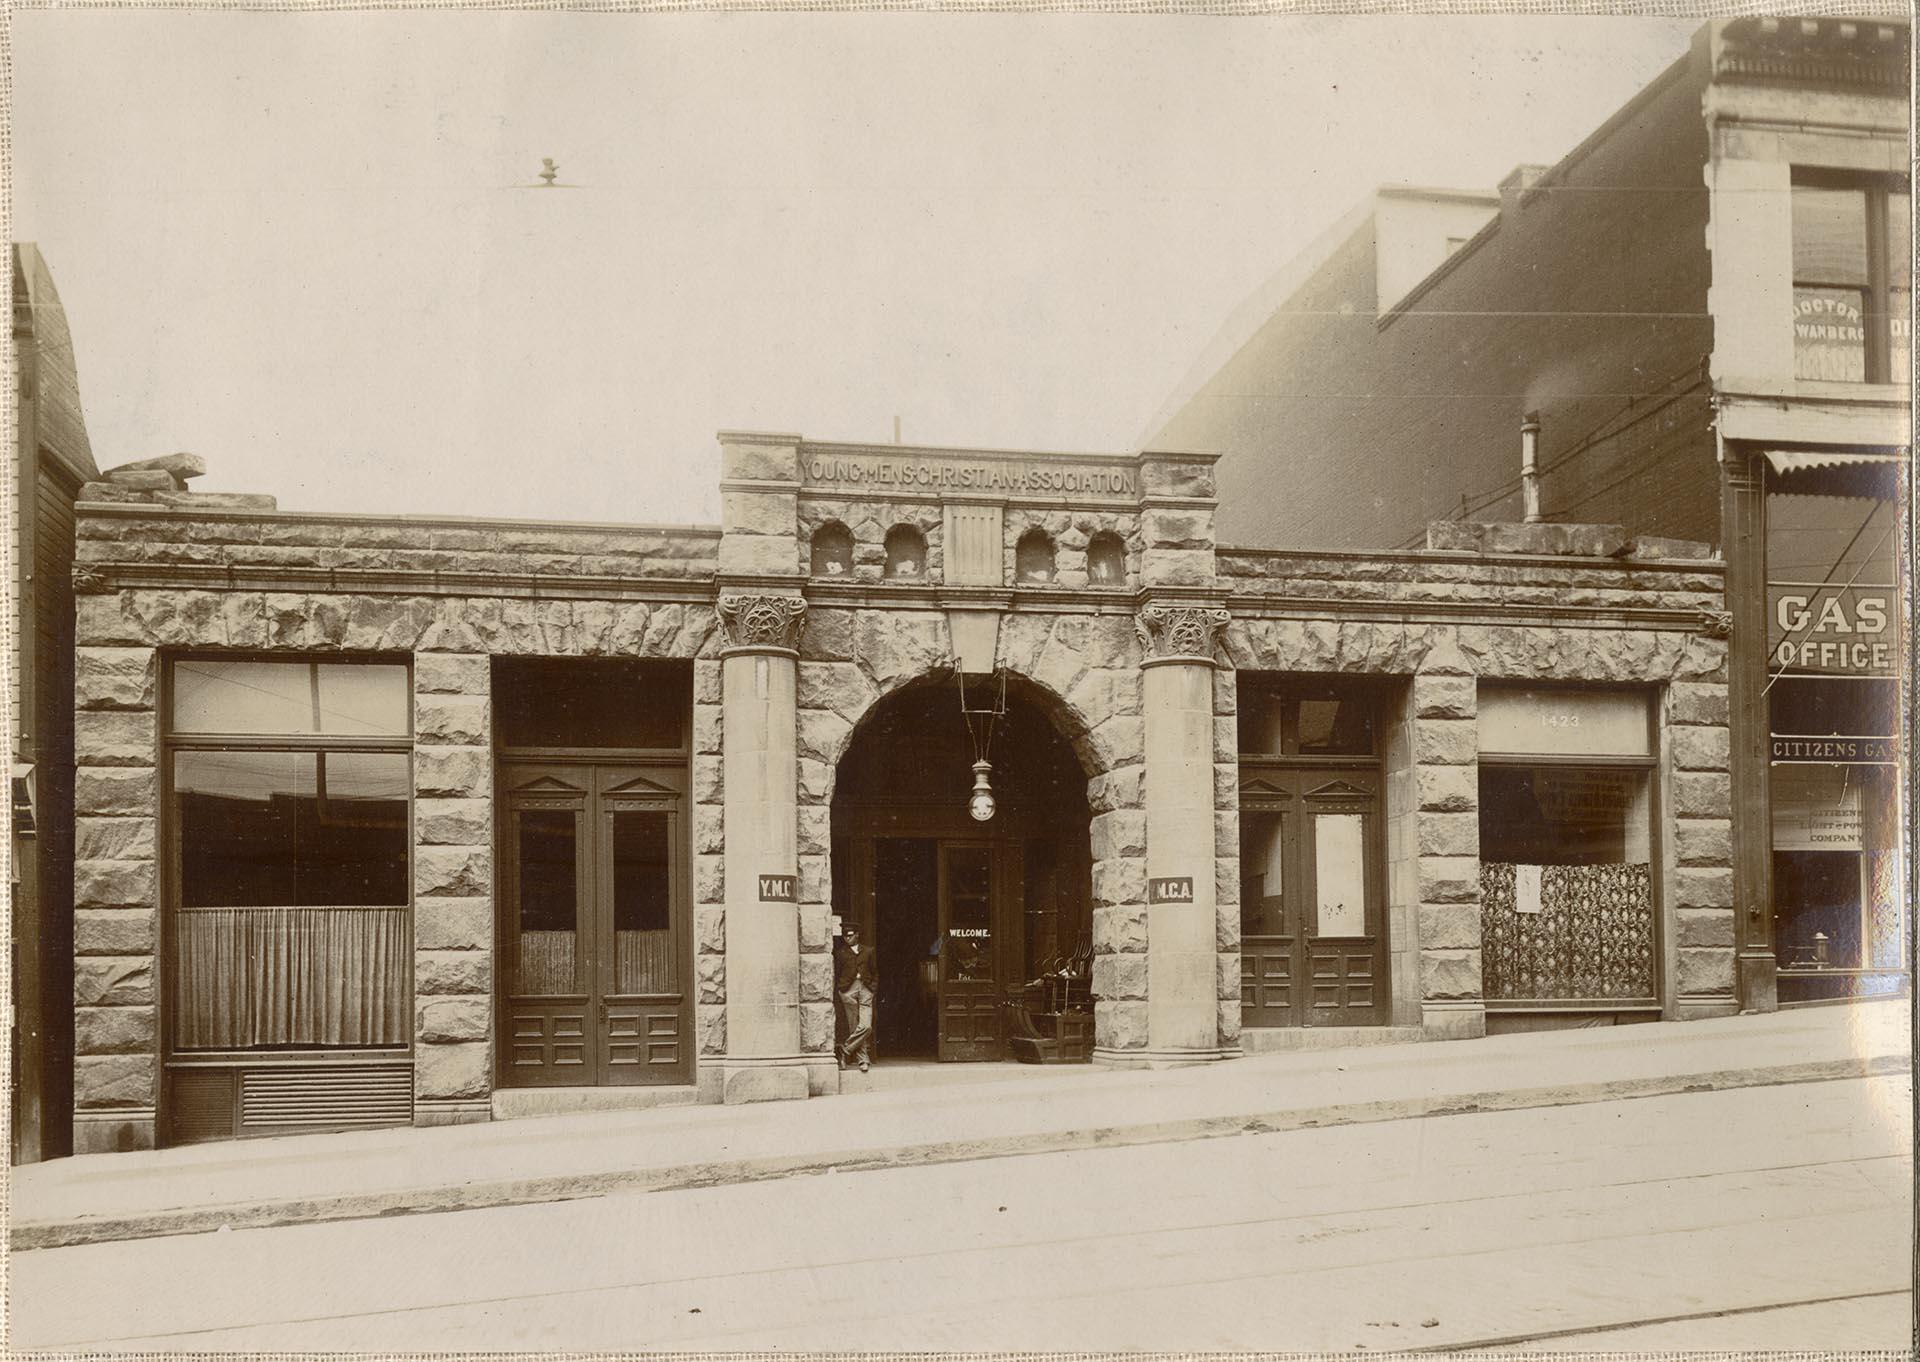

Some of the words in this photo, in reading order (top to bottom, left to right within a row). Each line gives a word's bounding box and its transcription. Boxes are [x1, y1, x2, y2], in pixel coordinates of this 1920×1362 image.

[1793, 298, 1858, 323] DOCTOR
[1017, 471, 1136, 495] ASSOCIATION
[1777, 596, 1887, 633] GAS
[1777, 640, 1889, 668] OFFICE
[1541, 715, 1580, 728] 1423
[1773, 742, 1857, 757] CITIZENS
[1810, 834, 1863, 842] COMPANY
